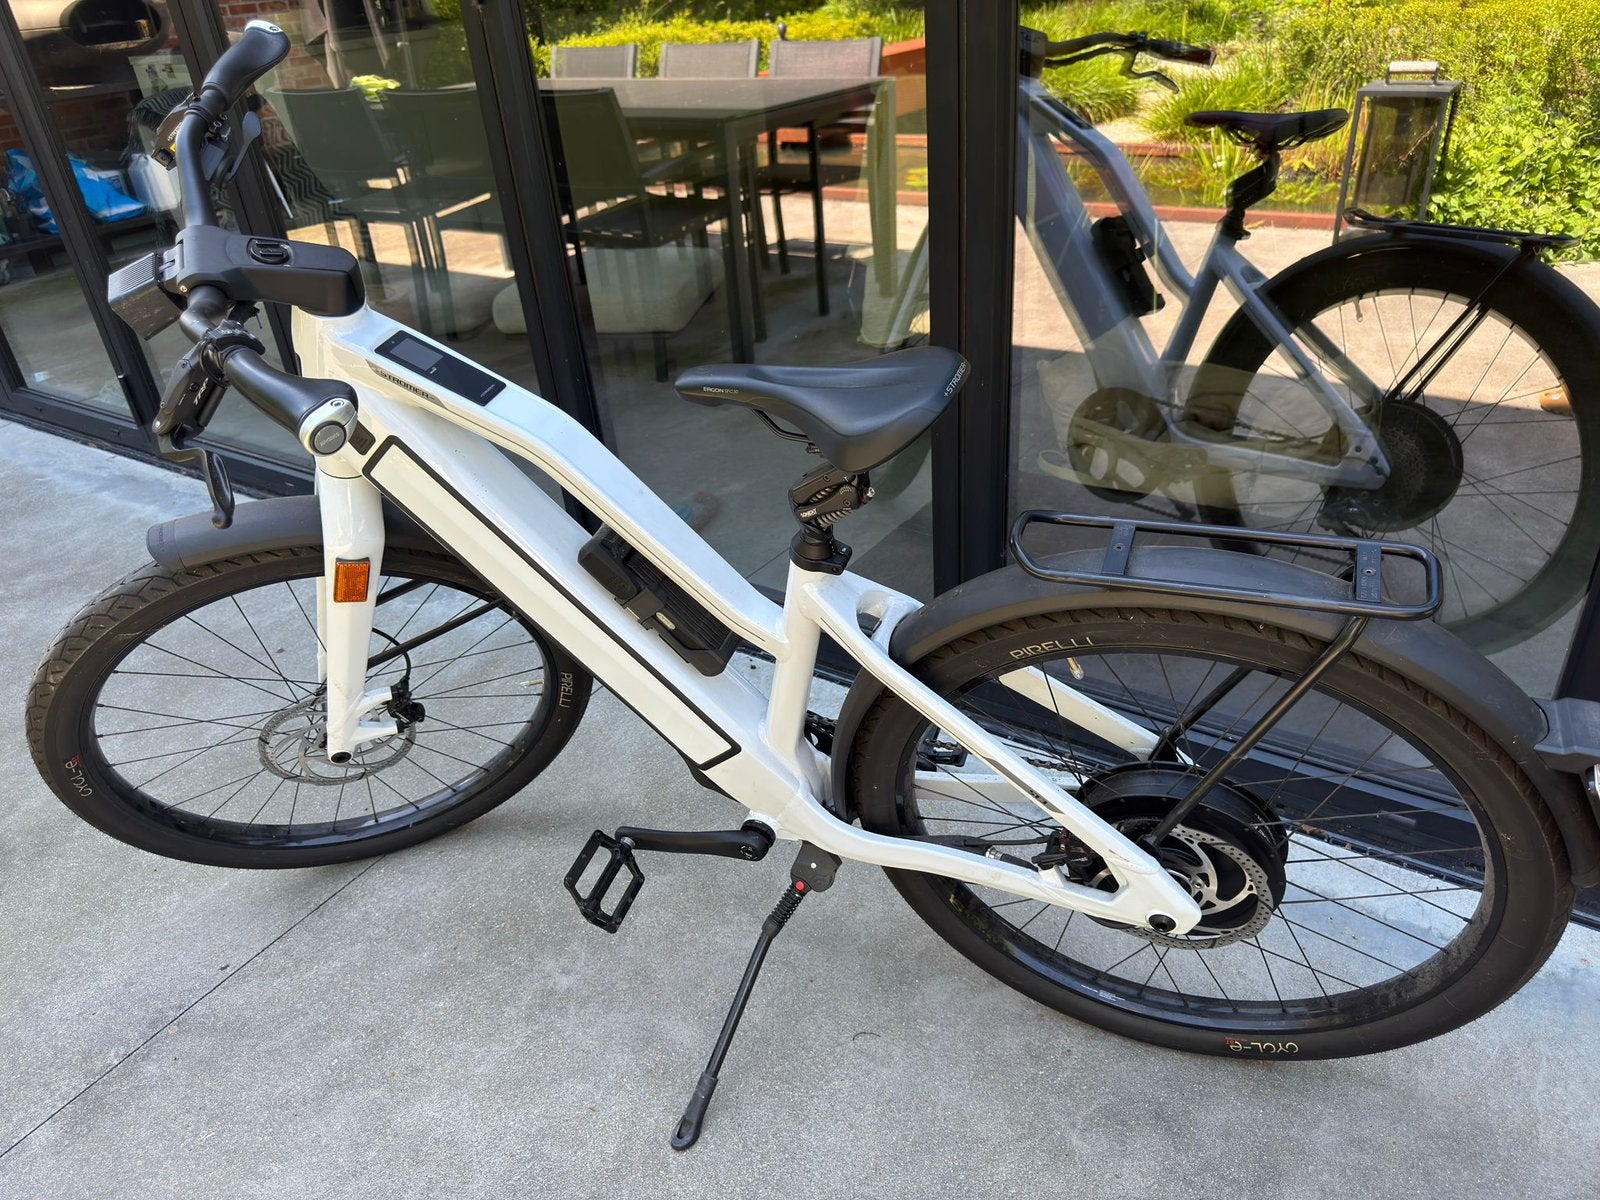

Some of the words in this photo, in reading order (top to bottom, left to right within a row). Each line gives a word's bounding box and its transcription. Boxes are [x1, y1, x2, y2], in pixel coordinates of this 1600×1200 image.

[946, 362, 966, 394] STROMER
[1009, 636, 1094, 660] PIRELLI
[560, 671, 573, 708] PIRELLI
